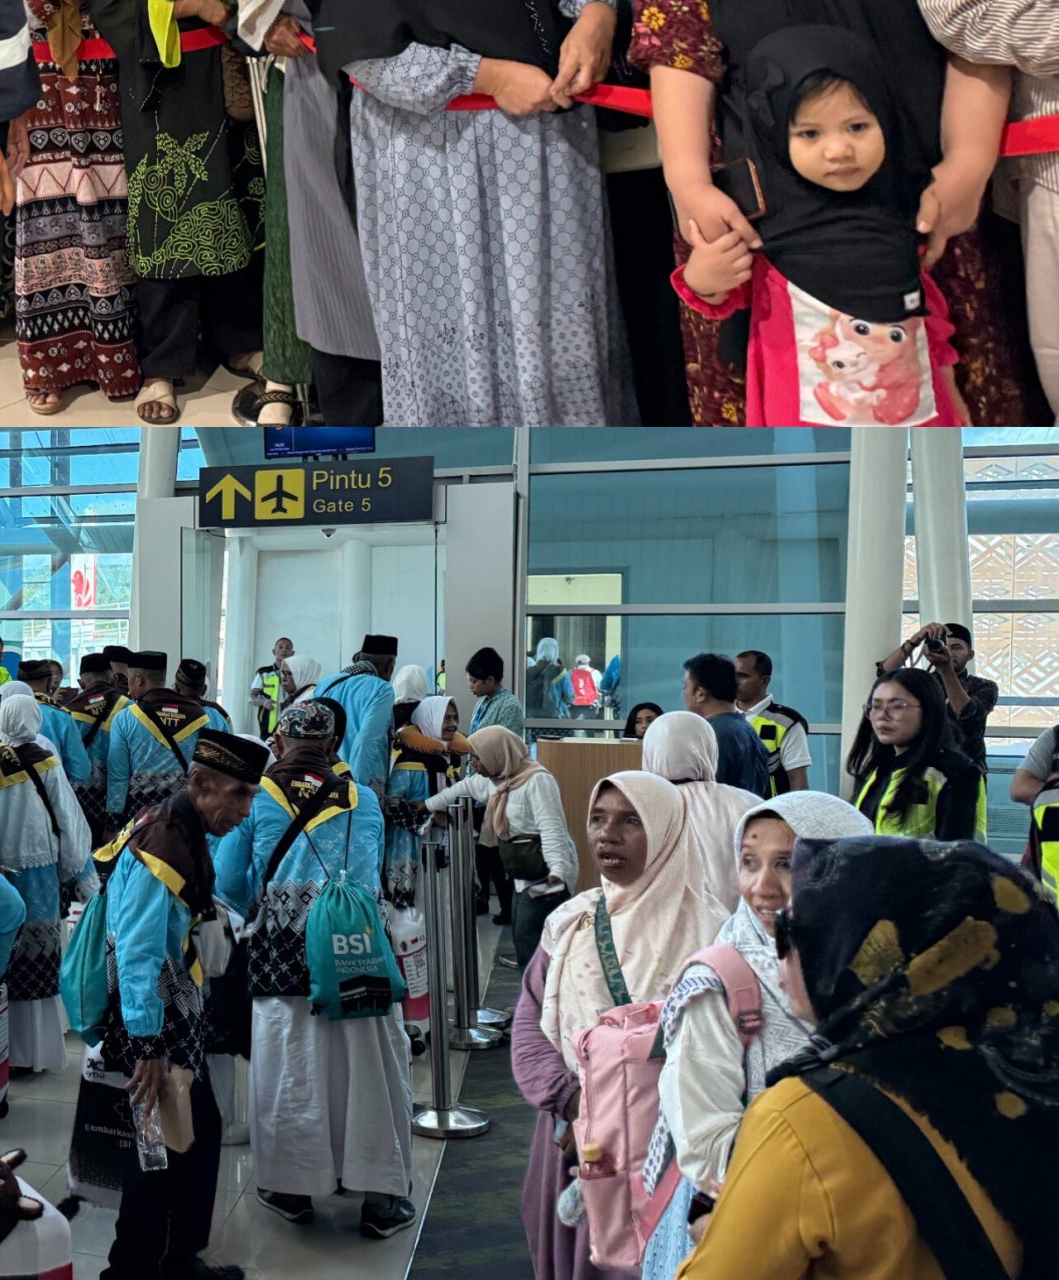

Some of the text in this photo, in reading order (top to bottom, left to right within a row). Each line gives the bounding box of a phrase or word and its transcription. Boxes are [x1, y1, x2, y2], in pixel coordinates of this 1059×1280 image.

[312, 467, 393, 491] Pintu 5
[312, 498, 371, 513] Gate 5
[332, 926, 372, 955] BSI
[335, 959, 357, 967] BANK
